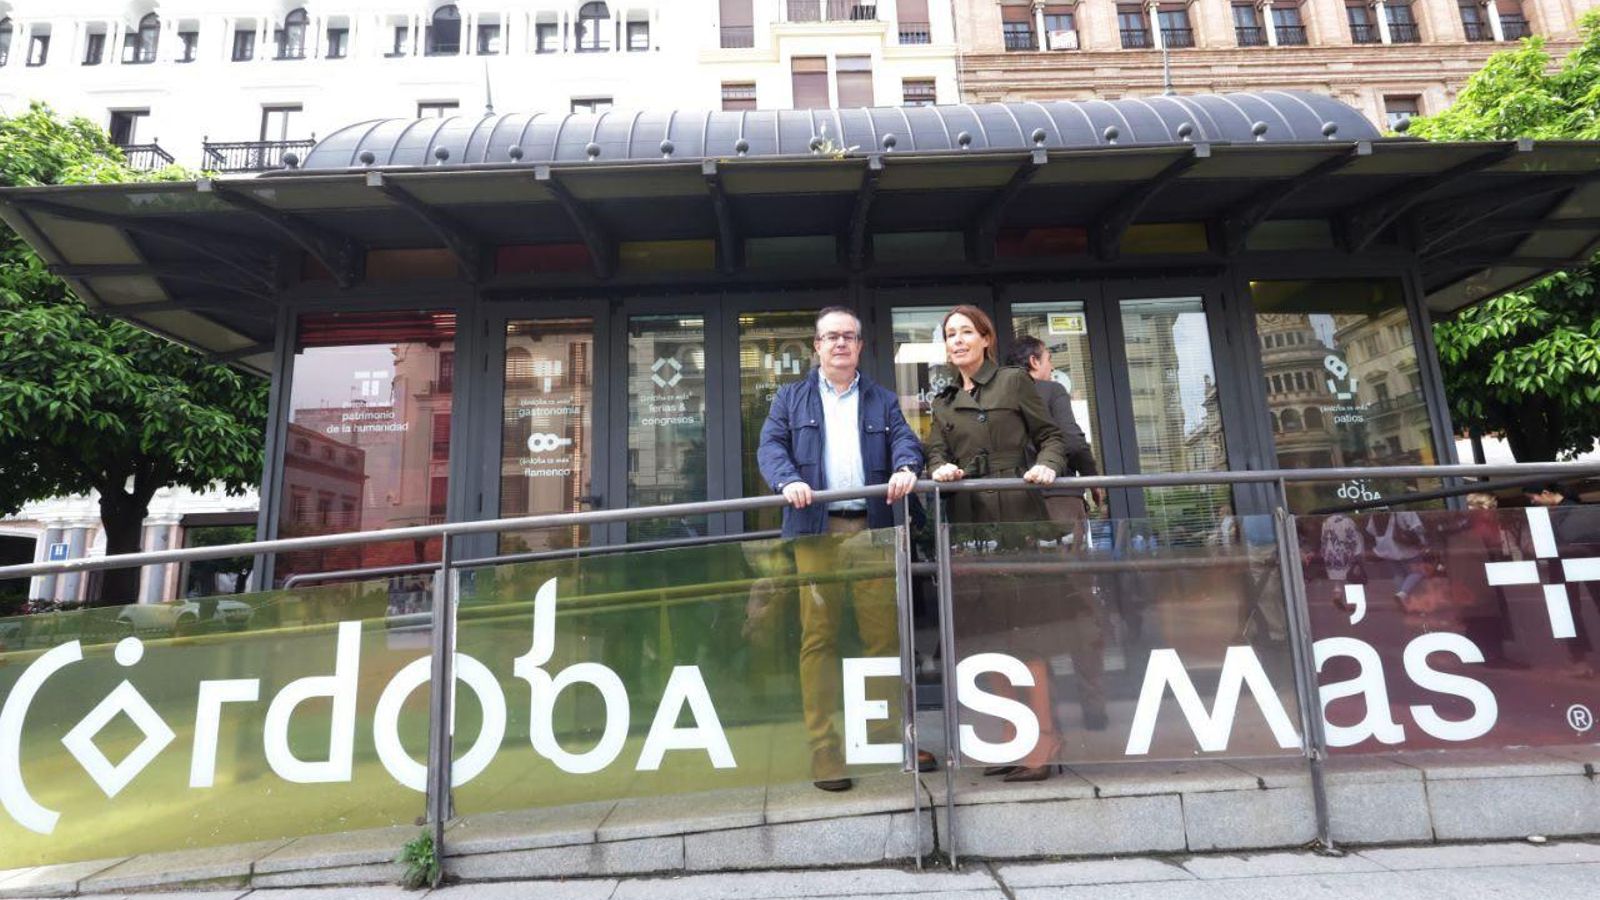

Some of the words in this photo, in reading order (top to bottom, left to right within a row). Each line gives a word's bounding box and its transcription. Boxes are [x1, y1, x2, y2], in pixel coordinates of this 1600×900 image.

[649, 403, 677, 413] ferias
[341, 411, 395, 422] patrimonio
[641, 416, 695, 427] congresos
[1334, 414, 1364, 424] patios
[326, 424, 340, 434] de
[341, 423, 351, 433] la
[353, 421, 409, 433] humanidad
[524, 467, 570, 478] flamenco
[842, 652, 1041, 764] ES
